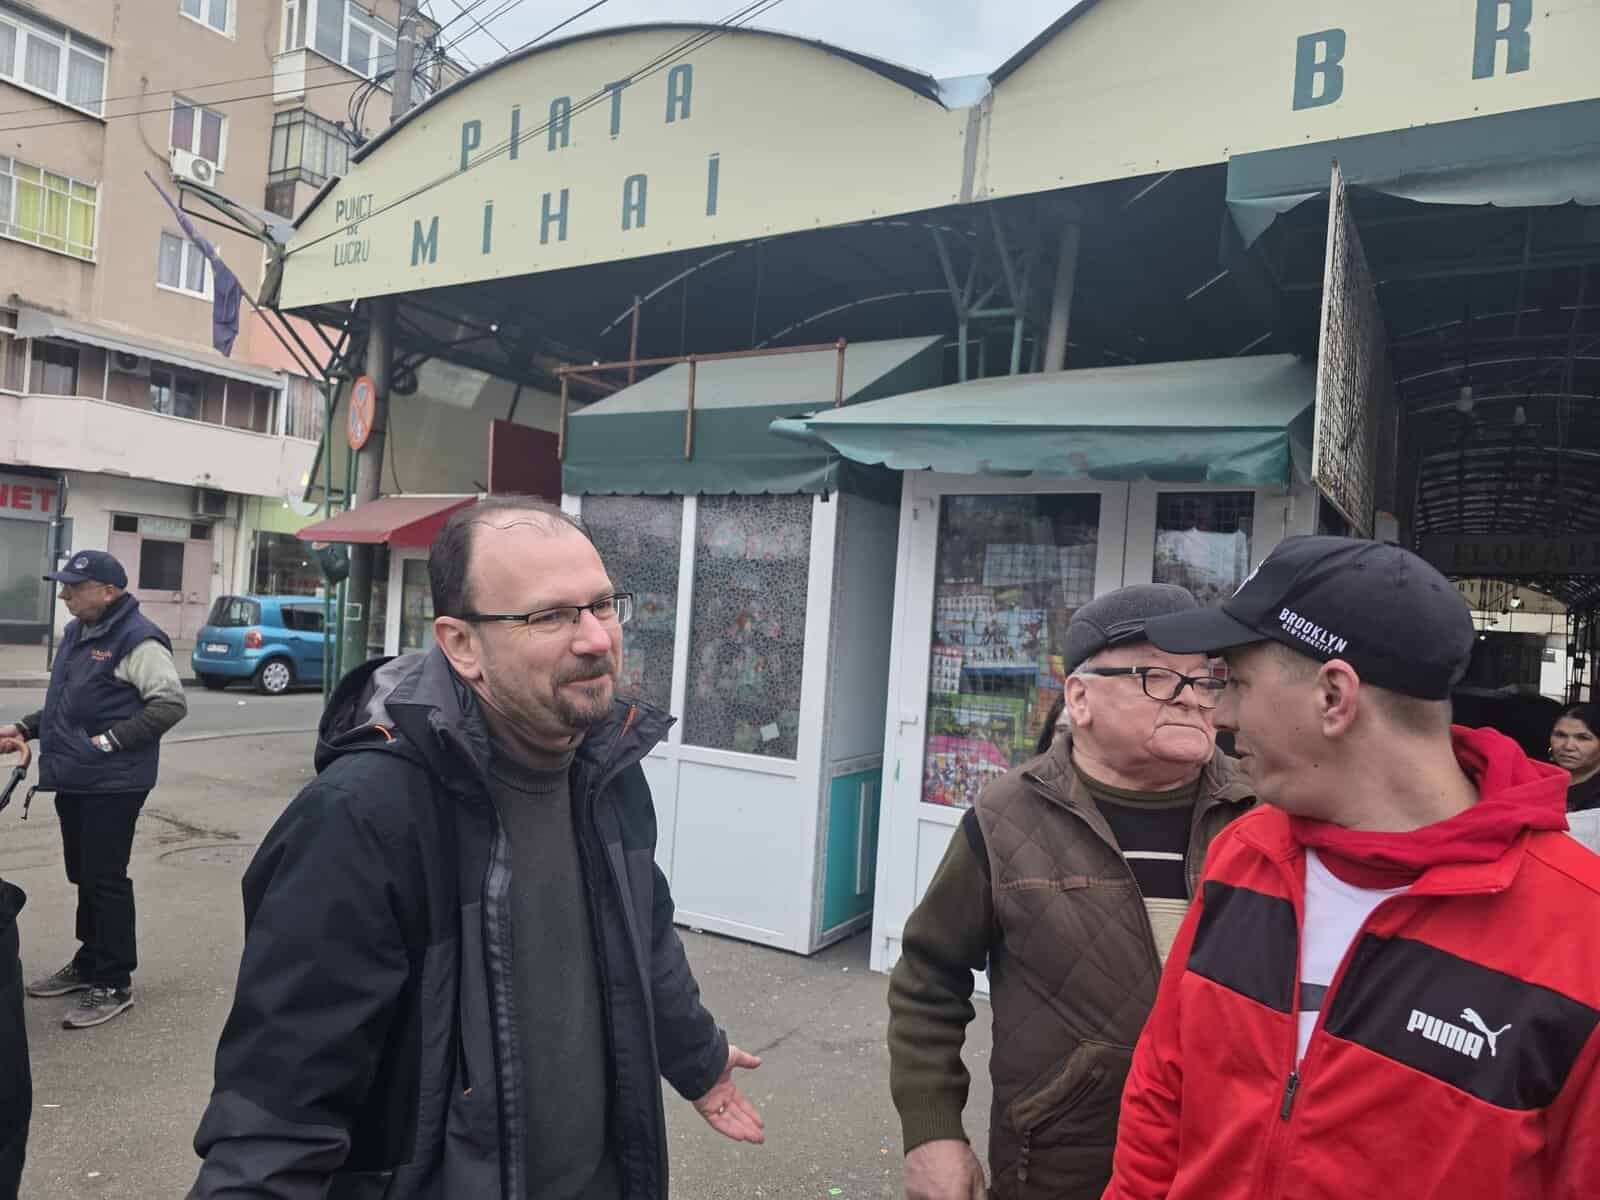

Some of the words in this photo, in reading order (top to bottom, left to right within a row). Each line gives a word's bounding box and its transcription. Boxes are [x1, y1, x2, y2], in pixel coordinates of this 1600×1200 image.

[335, 193, 374, 224] PUNCT
[334, 239, 370, 267] LUCRU
[1279, 607, 1348, 653] BROOKLYN
[1406, 1009, 1485, 1060] PUMA
